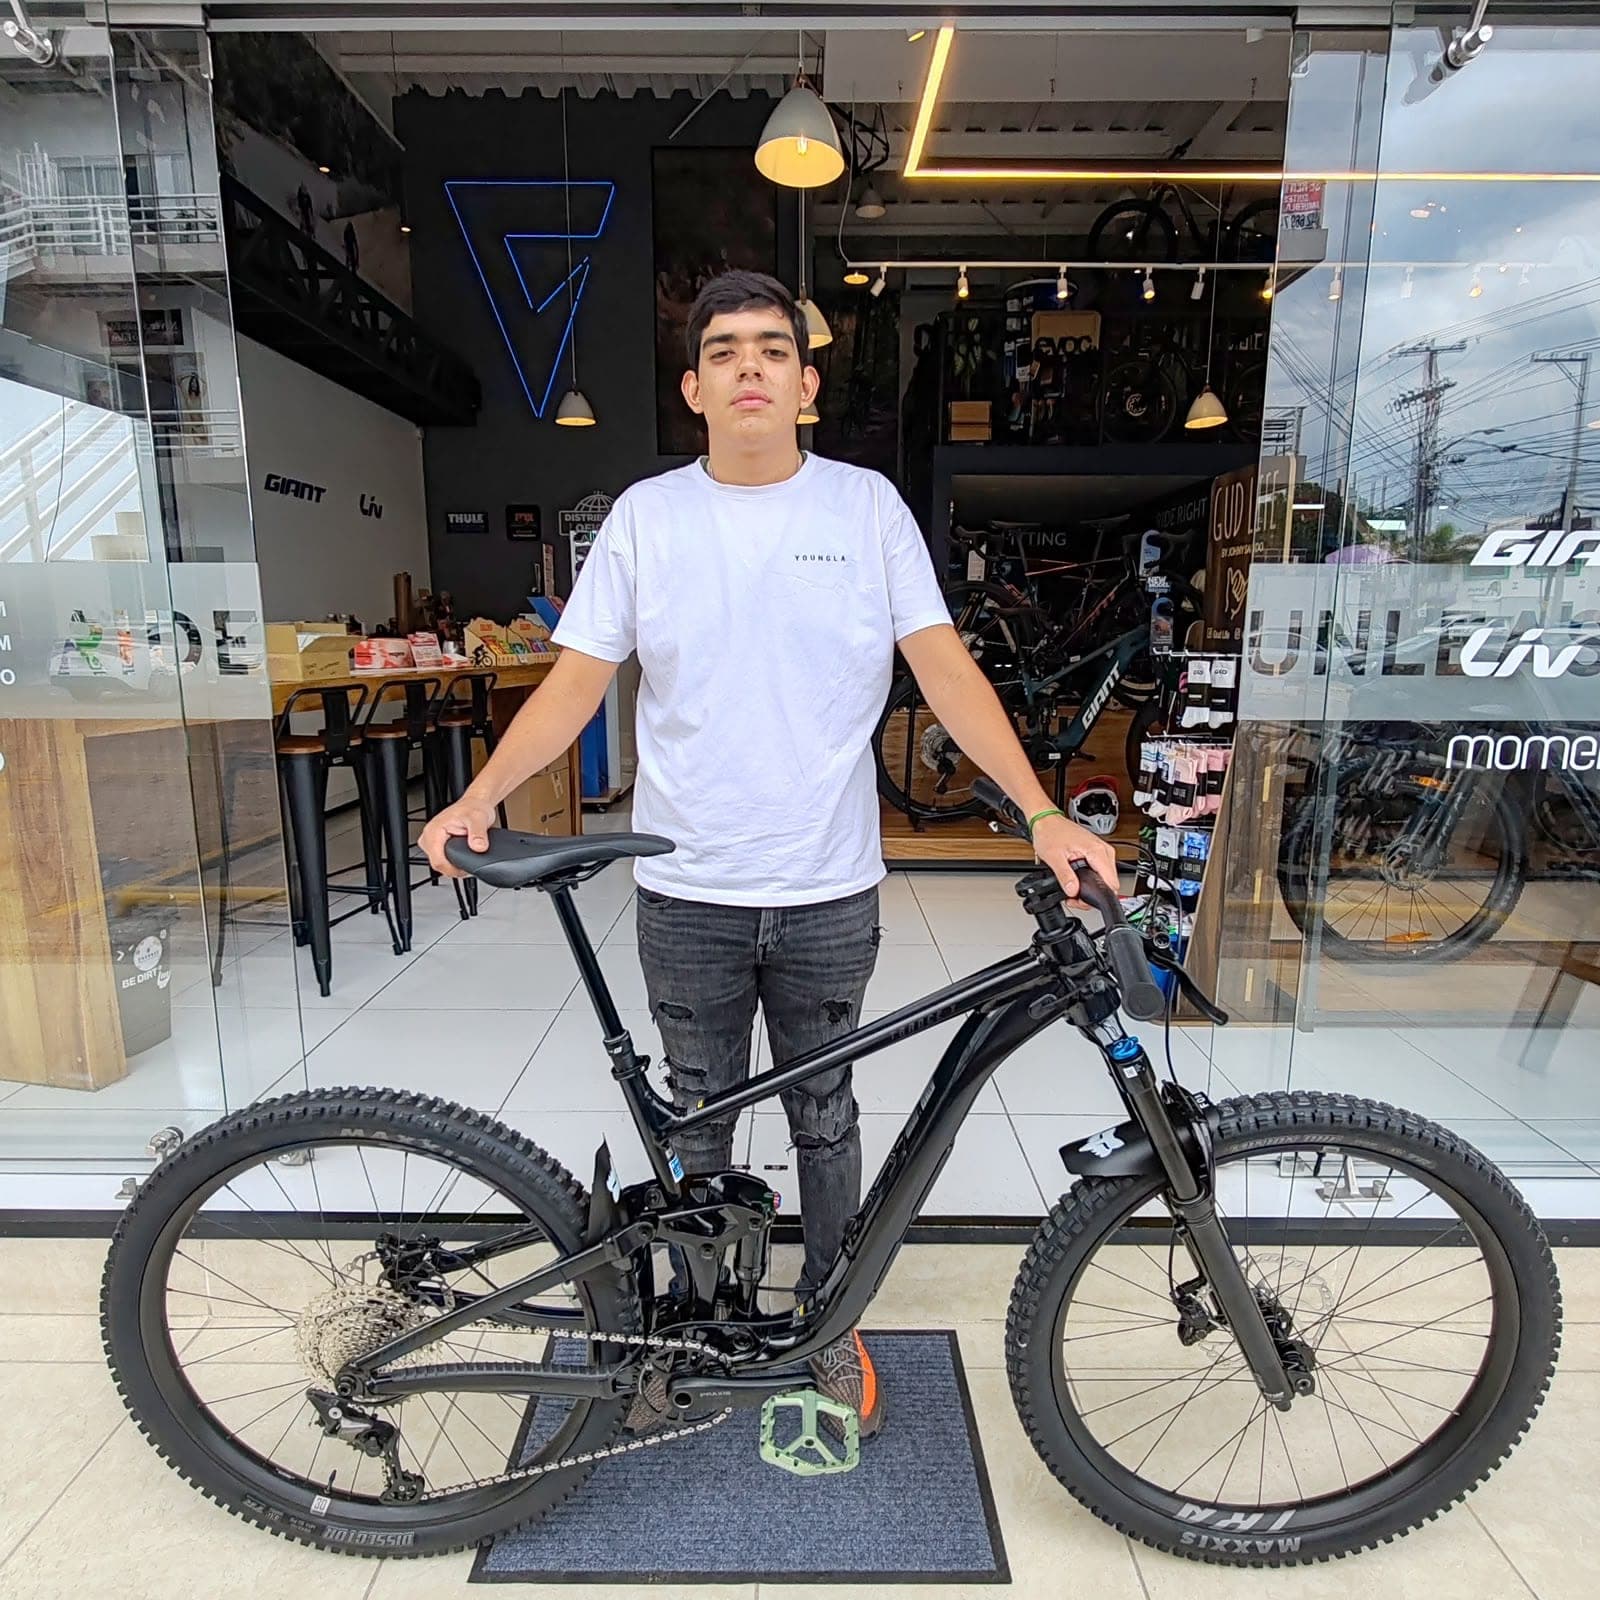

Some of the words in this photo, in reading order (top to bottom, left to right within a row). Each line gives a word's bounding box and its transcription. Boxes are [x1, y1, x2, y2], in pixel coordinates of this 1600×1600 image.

[263, 473, 327, 503] GIANT
[359, 493, 383, 520] Liv
[447, 513, 484, 524] THULE
[1177, 497, 1208, 521] RIGHT
[1213, 482, 1244, 541] GUD
[1460, 628, 1583, 678] Liv
[1082, 660, 1120, 731] GIANT
[1446, 734, 1600, 771] mome
[122, 976, 137, 989] BE
[322, 1524, 416, 1547] DISSECTOR
[1180, 1530, 1301, 1555] MAXXIS
